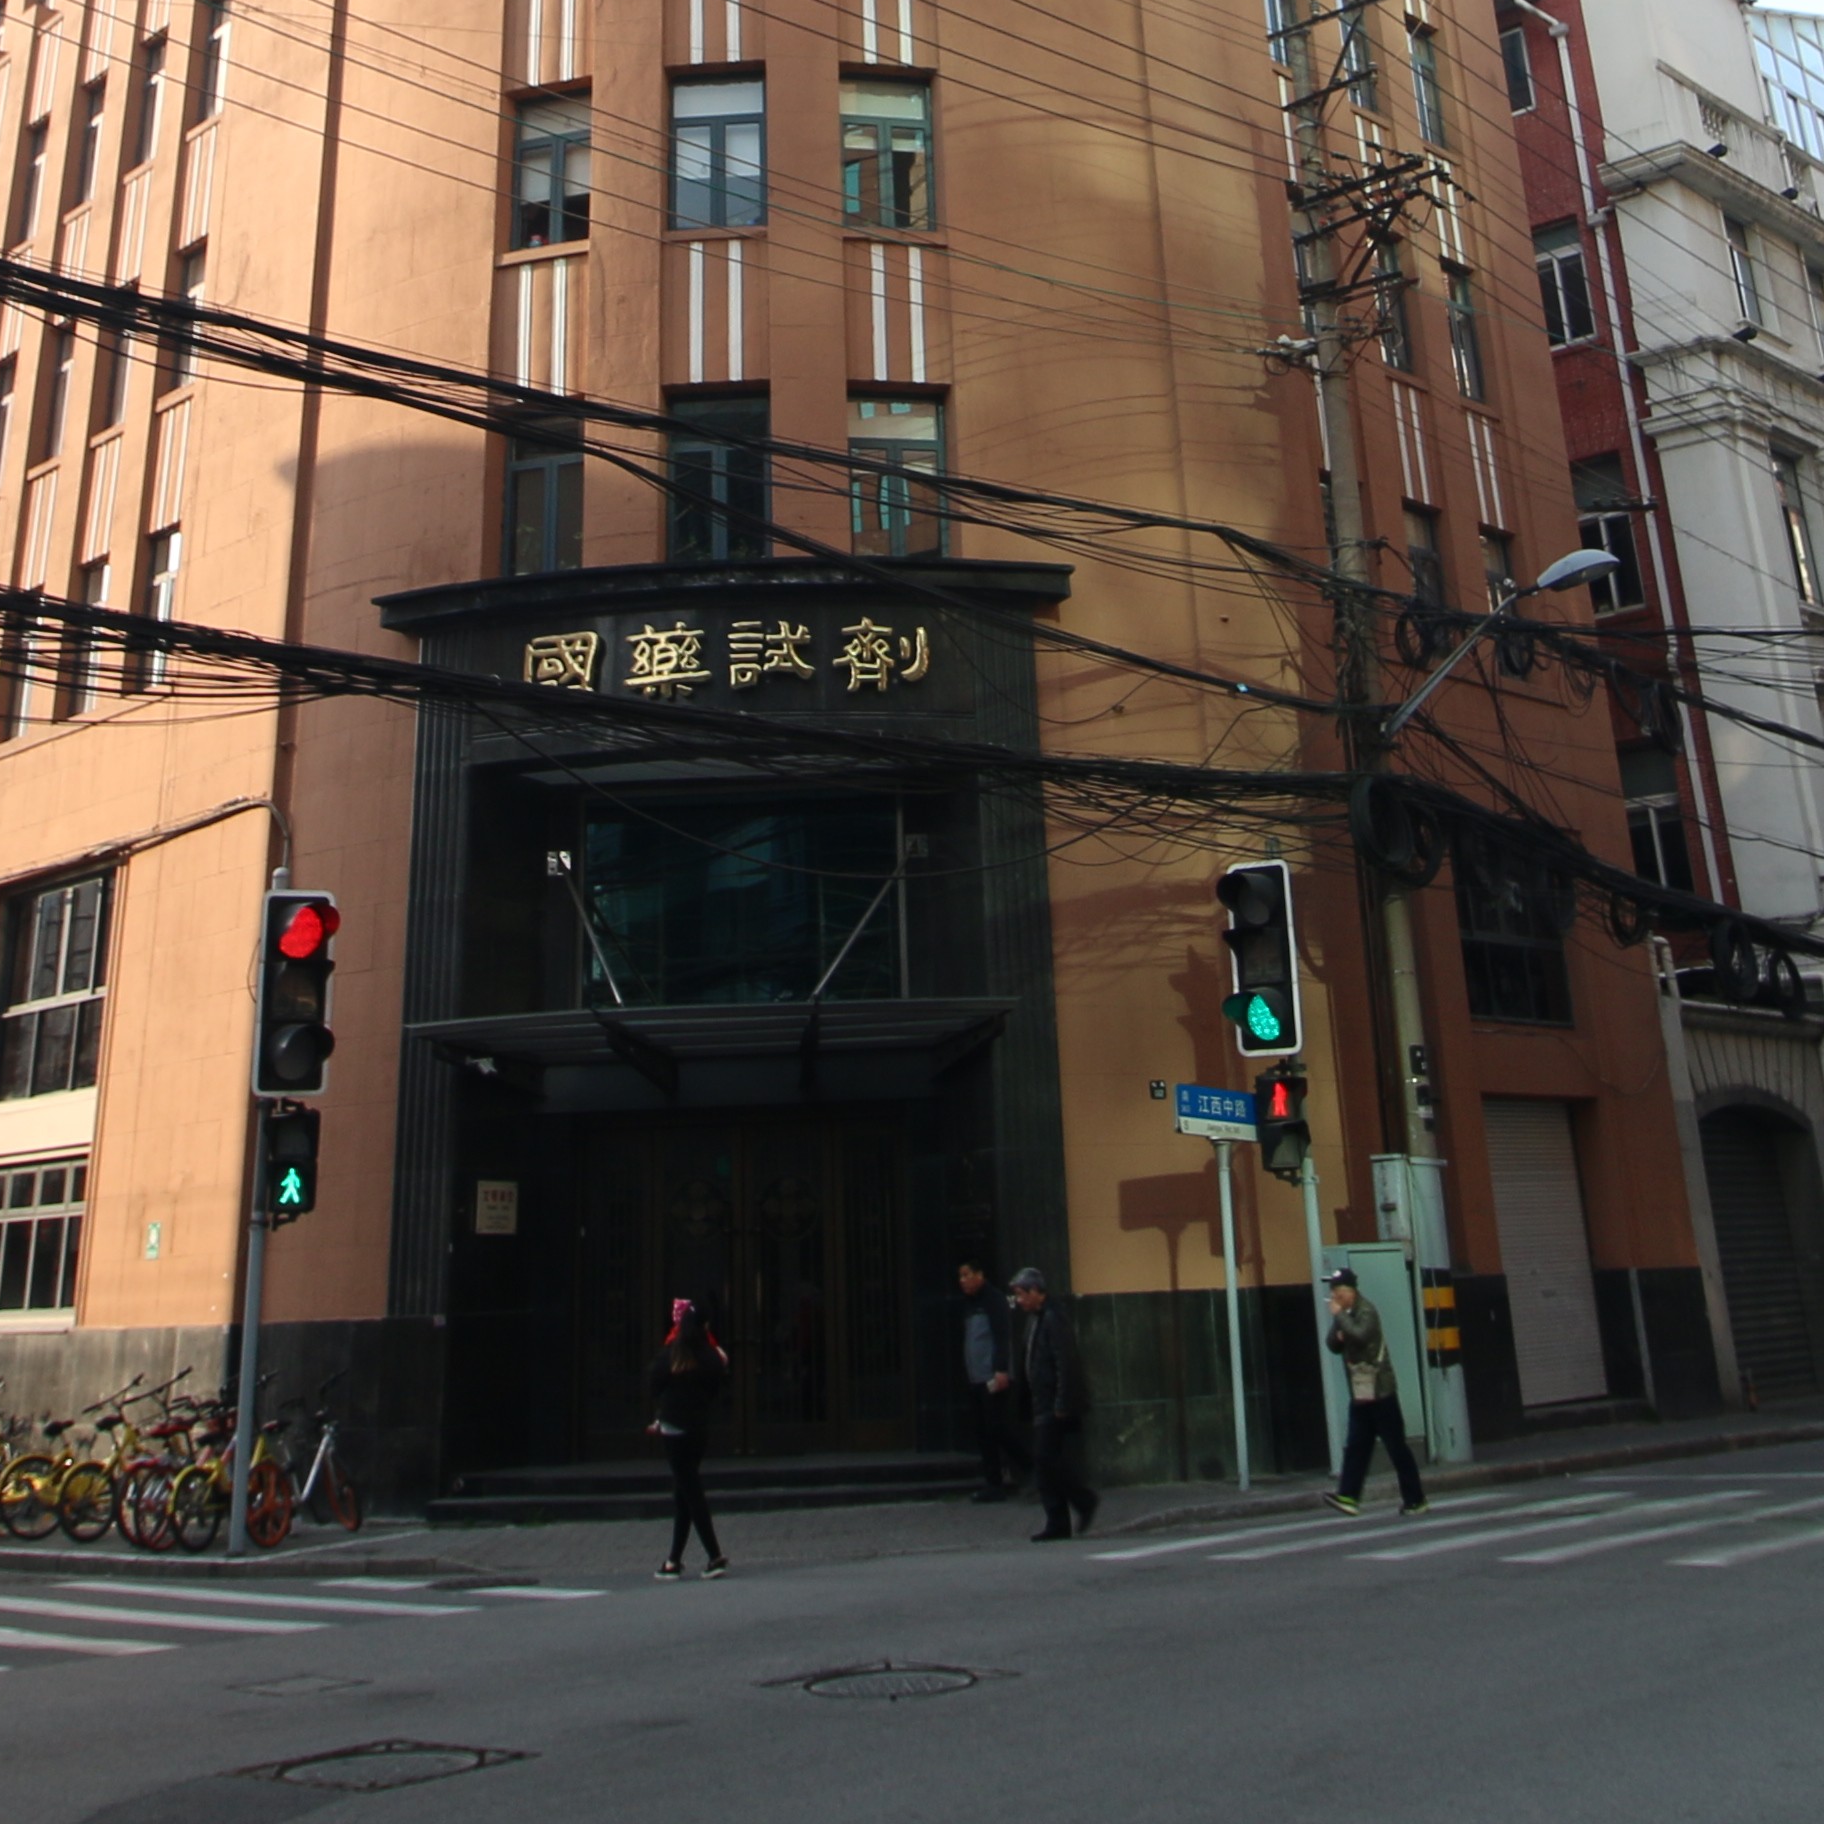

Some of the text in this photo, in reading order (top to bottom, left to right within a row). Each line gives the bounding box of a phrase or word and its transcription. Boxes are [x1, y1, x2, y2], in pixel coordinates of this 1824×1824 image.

[523, 616, 929, 697] 國藥試劑
[1198, 1094, 1246, 1118] 江西中路
